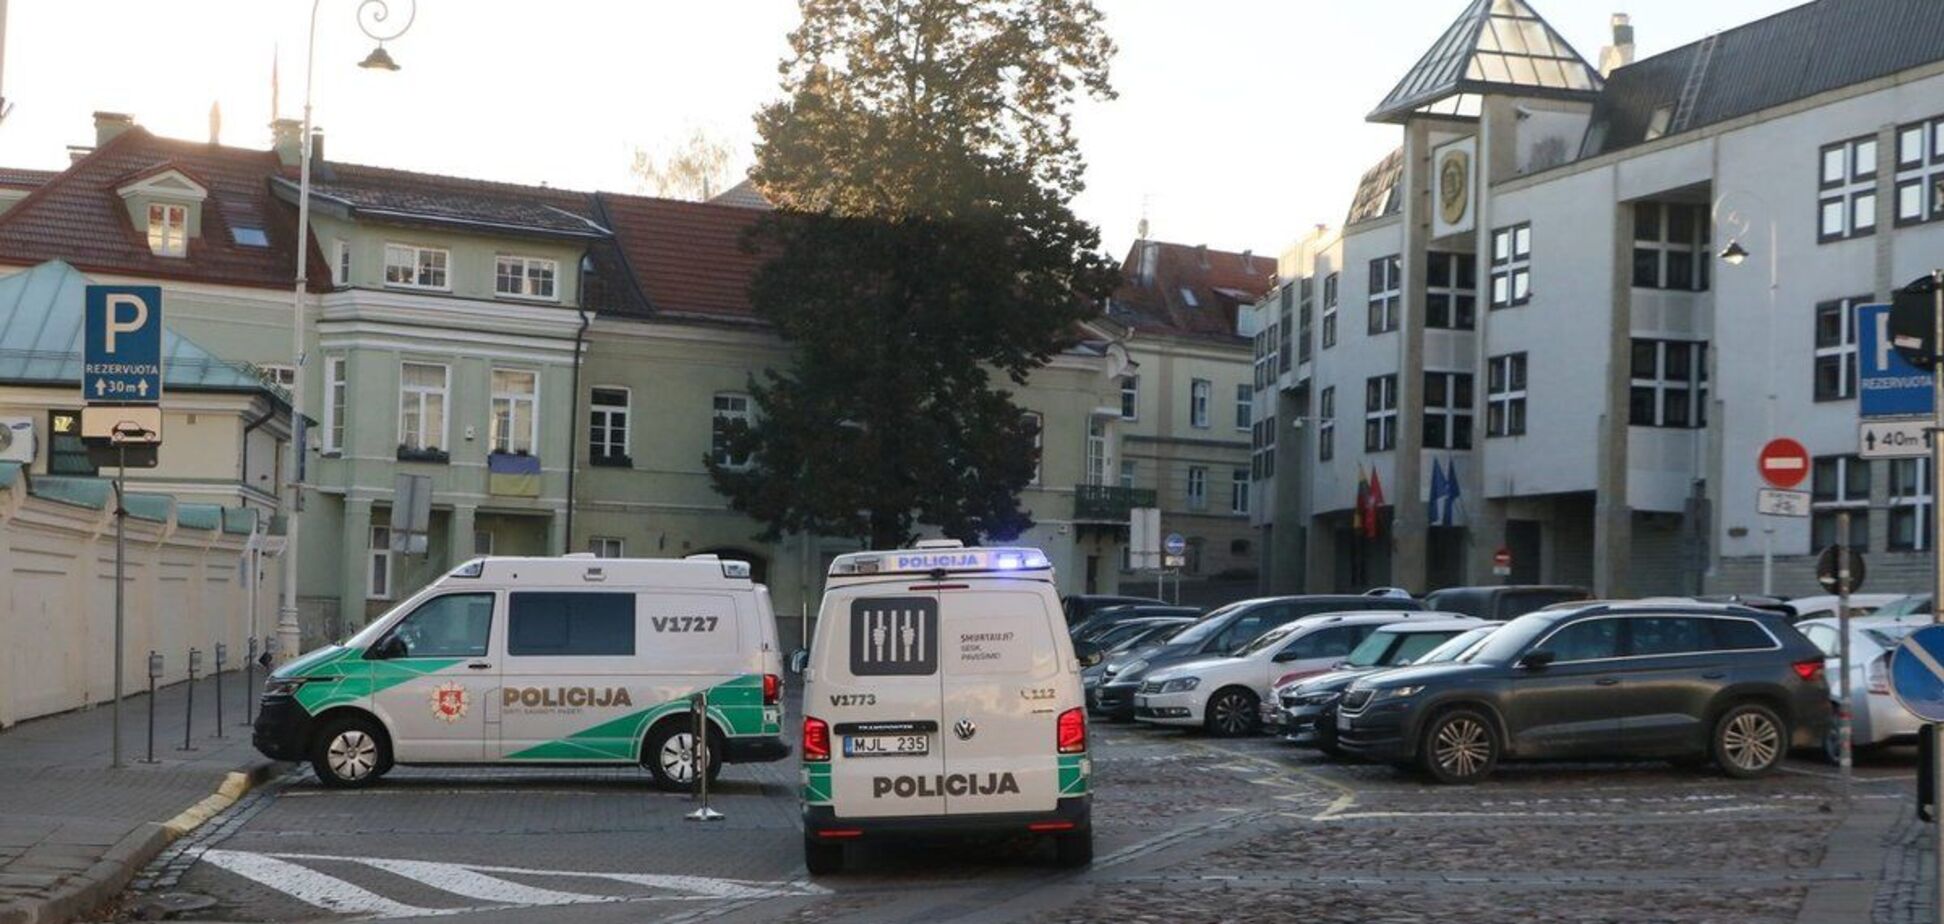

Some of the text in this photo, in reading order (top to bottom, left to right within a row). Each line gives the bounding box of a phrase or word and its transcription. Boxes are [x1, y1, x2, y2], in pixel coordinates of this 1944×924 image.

[105, 293, 148, 353] P
[86, 363, 158, 374] REZERVUOTA
[898, 554, 978, 569] POLICIJA
[651, 616, 719, 632] V1727
[503, 686, 633, 707] POLICIJA
[830, 694, 877, 706] V1773
[854, 736, 925, 752] MJL 235
[873, 772, 1021, 798] POLICIJA
